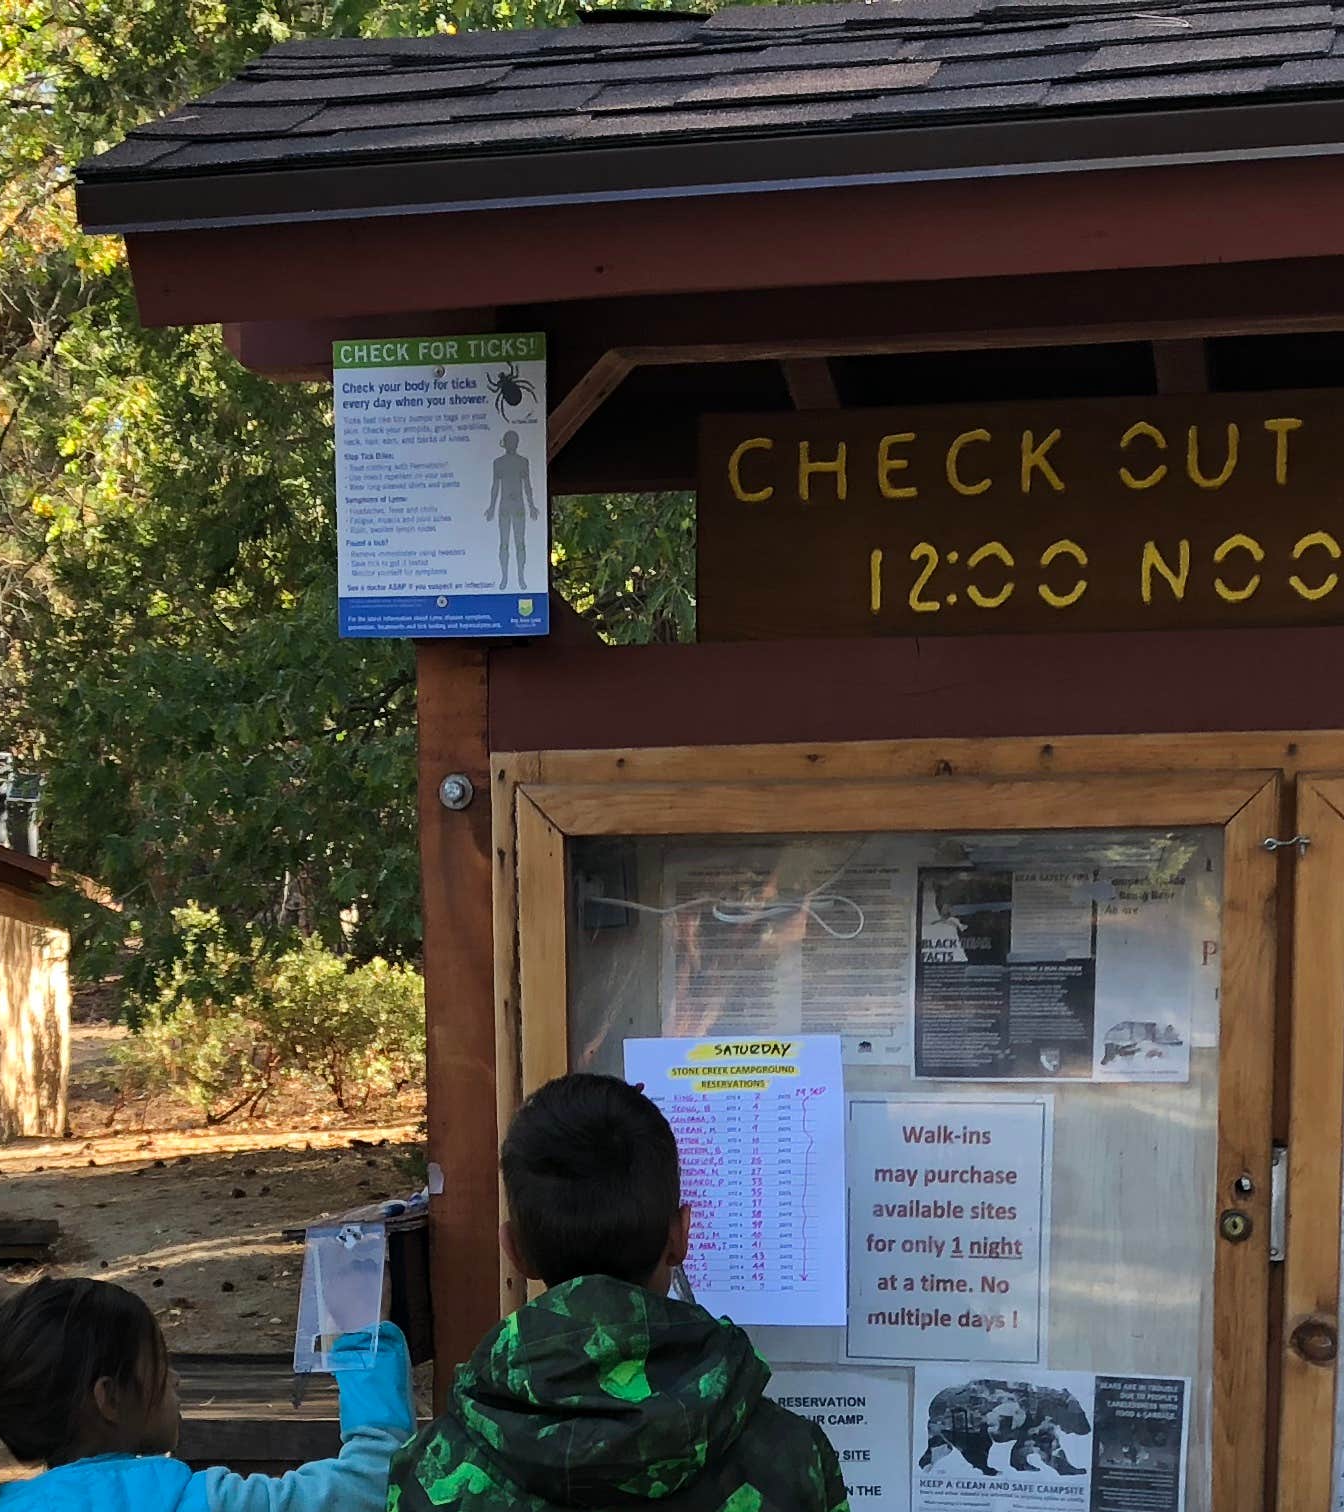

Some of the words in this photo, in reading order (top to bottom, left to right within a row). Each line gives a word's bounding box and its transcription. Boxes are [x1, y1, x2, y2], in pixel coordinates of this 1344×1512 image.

[340, 343, 409, 364] CHECK
[419, 341, 458, 361] FOR
[467, 337, 535, 358] TICKS!
[342, 381, 374, 394] Check
[378, 383, 400, 397] your
[405, 380, 430, 396] body
[433, 379, 448, 391] for
[452, 378, 477, 390] ticks
[342, 399, 369, 411] every
[373, 397, 391, 410] day
[395, 396, 423, 407] when
[427, 396, 446, 409] you
[450, 394, 489, 406] shower.
[727, 428, 1067, 502] CHECK
[1118, 417, 1303, 491] OUT
[869, 539, 1089, 613] 12:00
[714, 1042, 792, 1058] SATURDAY
[672, 1067, 699, 1076] STONE
[702, 1066, 728, 1075] CREEK
[730, 1065, 795, 1074] CAMPGROUND
[701, 1079, 765, 1089] RESERVATIONS
[902, 1125, 992, 1146] Walk-ins
[874, 1168, 918, 1187] may
[924, 1165, 1018, 1187] purchase
[872, 1199, 964, 1220] available
[970, 1201, 1017, 1220] sites
[866, 1233, 896, 1253] for
[901, 1235, 946, 1258] only
[951, 1236, 963, 1255] 1
[969, 1236, 1023, 1258] night
[877, 1274, 897, 1292] at
[903, 1278, 914, 1292] a
[920, 1274, 973, 1293] time.
[981, 1276, 1010, 1294] No
[867, 1308, 952, 1331] multiple
[958, 1311, 1005, 1332] days
[777, 1396, 866, 1408] RESERVATION
[827, 1414, 868, 1425] CAMP.
[842, 1450, 871, 1461] SITE
[856, 1485, 882, 1496] THE
[919, 1479, 944, 1488] KEEP
[946, 1480, 953, 1488] A
[955, 1481, 986, 1490] CLEAN
[989, 1482, 1010, 1491] AND
[1011, 1483, 1034, 1492] SAFE
[1036, 1485, 1085, 1496] CAMPSITE
